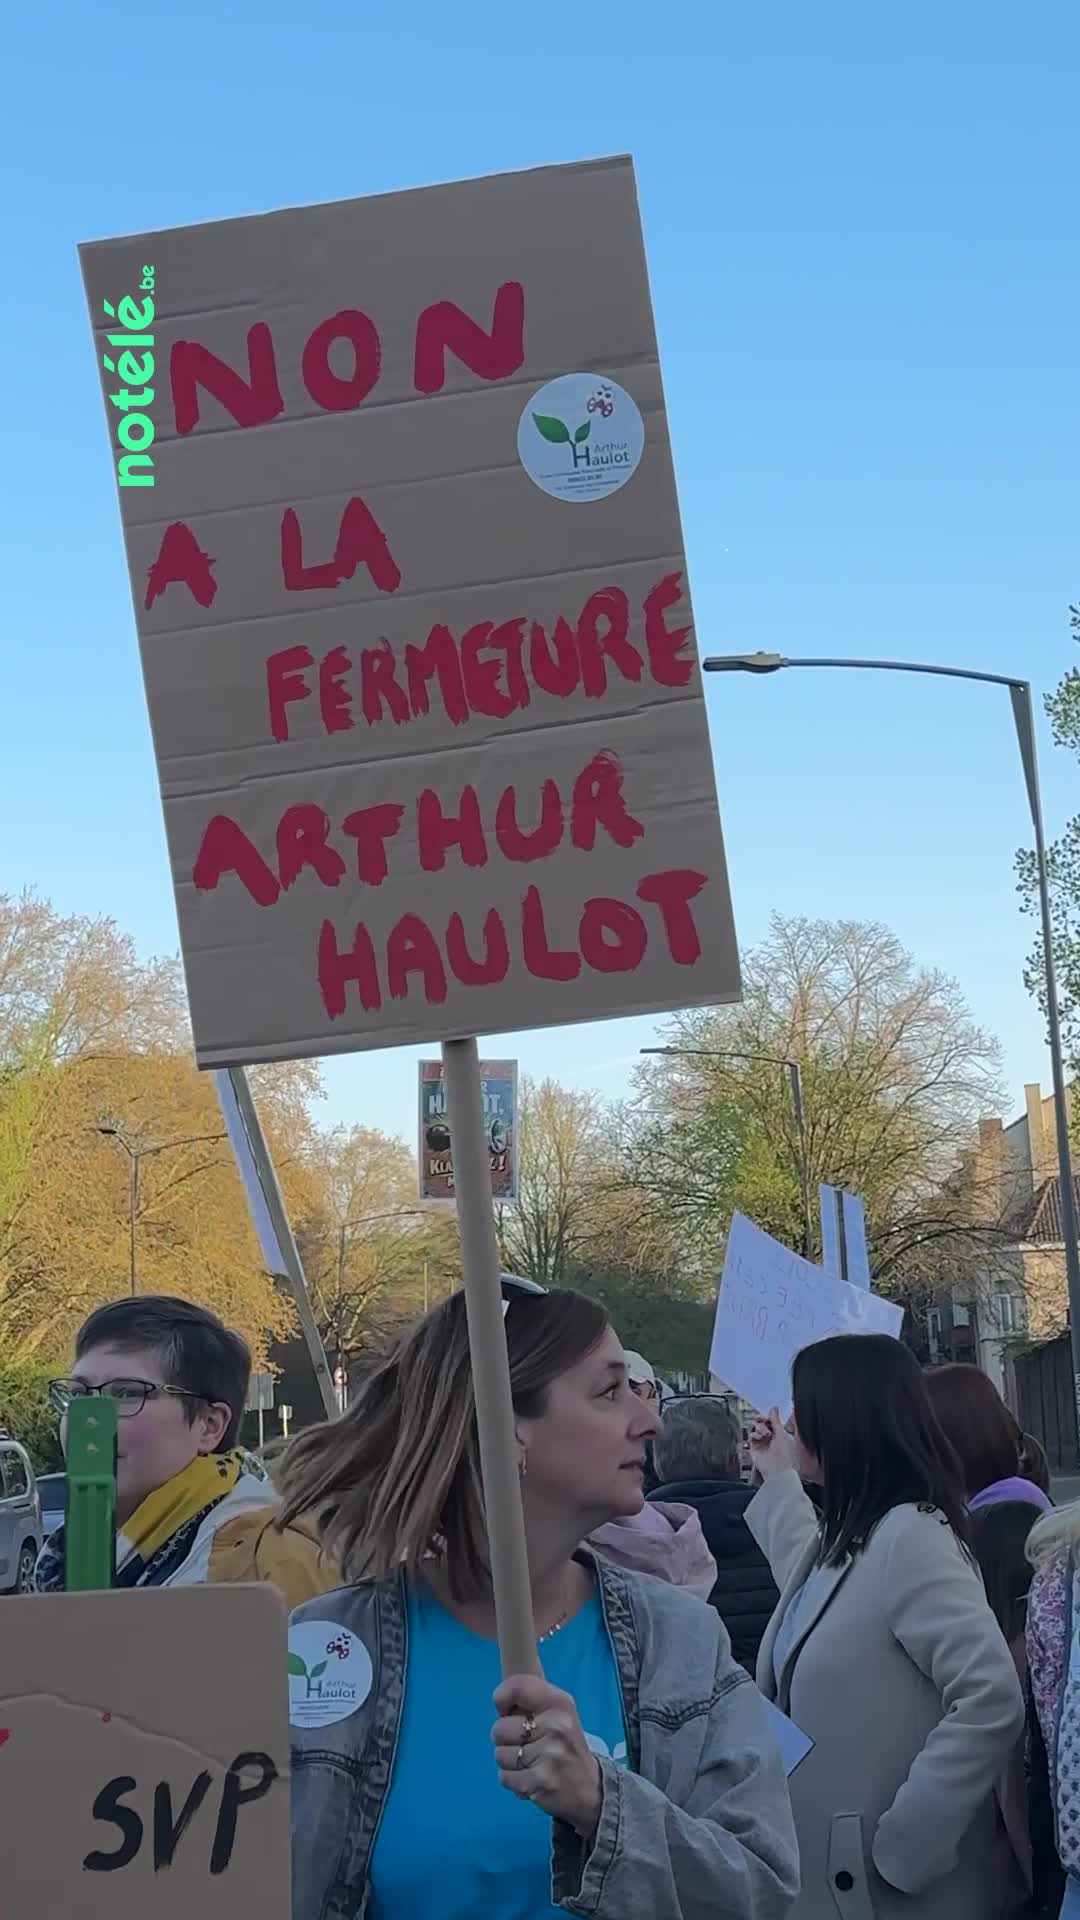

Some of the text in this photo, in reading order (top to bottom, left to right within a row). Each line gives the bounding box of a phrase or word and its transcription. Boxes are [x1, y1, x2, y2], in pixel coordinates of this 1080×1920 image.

[170, 281, 524, 433] NON
[571, 444, 630, 469] Haulot
[146, 497, 401, 608] A LA
[267, 571, 695, 741] FERMETURE
[193, 749, 645, 906] ARTHUR
[318, 870, 708, 1020] HAULOT
[82, 1752, 279, 1875] SVP
